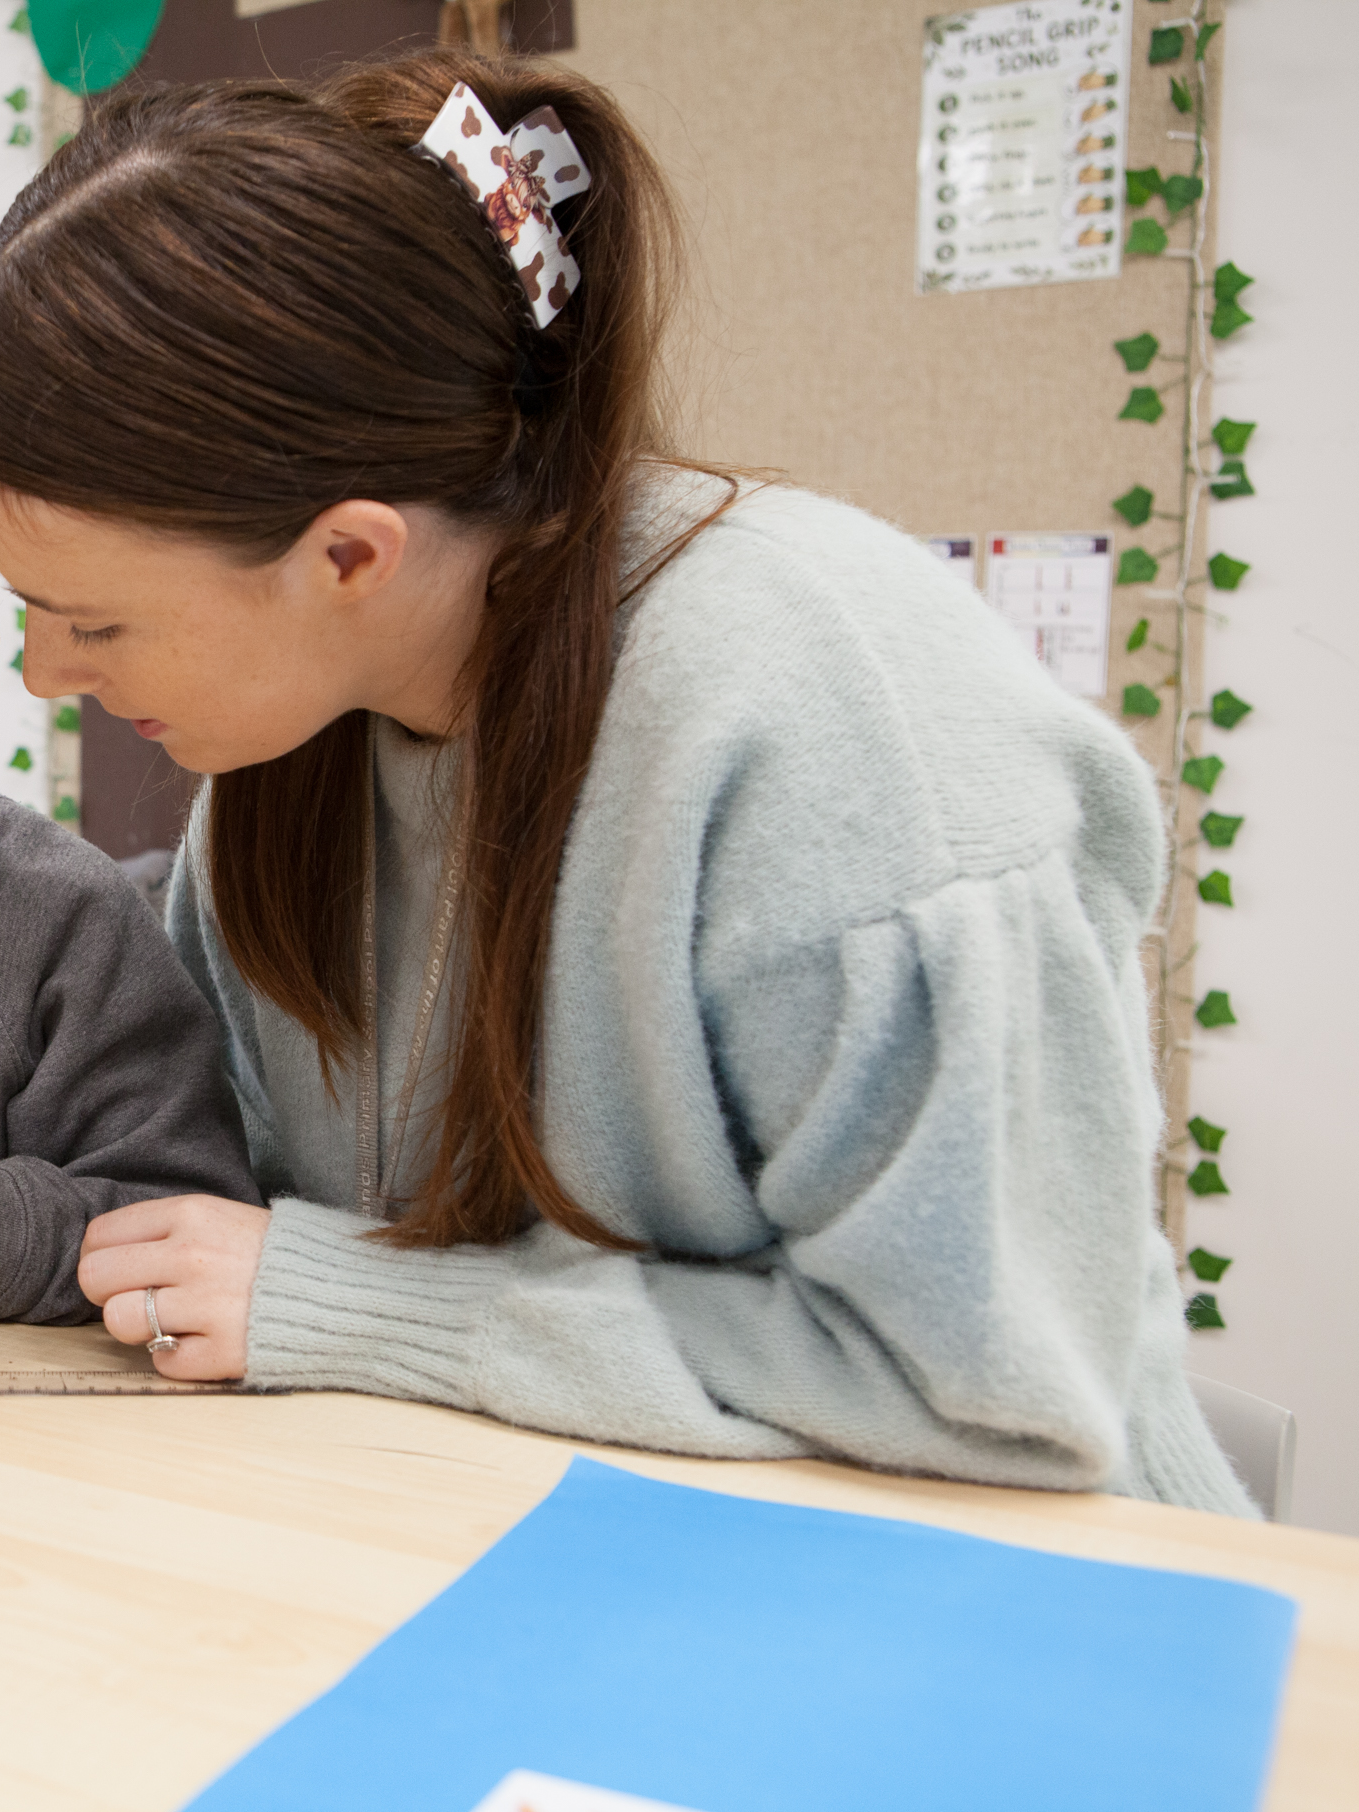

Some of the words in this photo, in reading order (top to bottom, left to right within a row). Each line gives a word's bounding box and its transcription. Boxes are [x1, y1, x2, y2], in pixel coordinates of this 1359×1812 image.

[961, 27, 1034, 56] PENCIL
[1046, 15, 1100, 42] GRIP
[998, 46, 1060, 76] SONG
